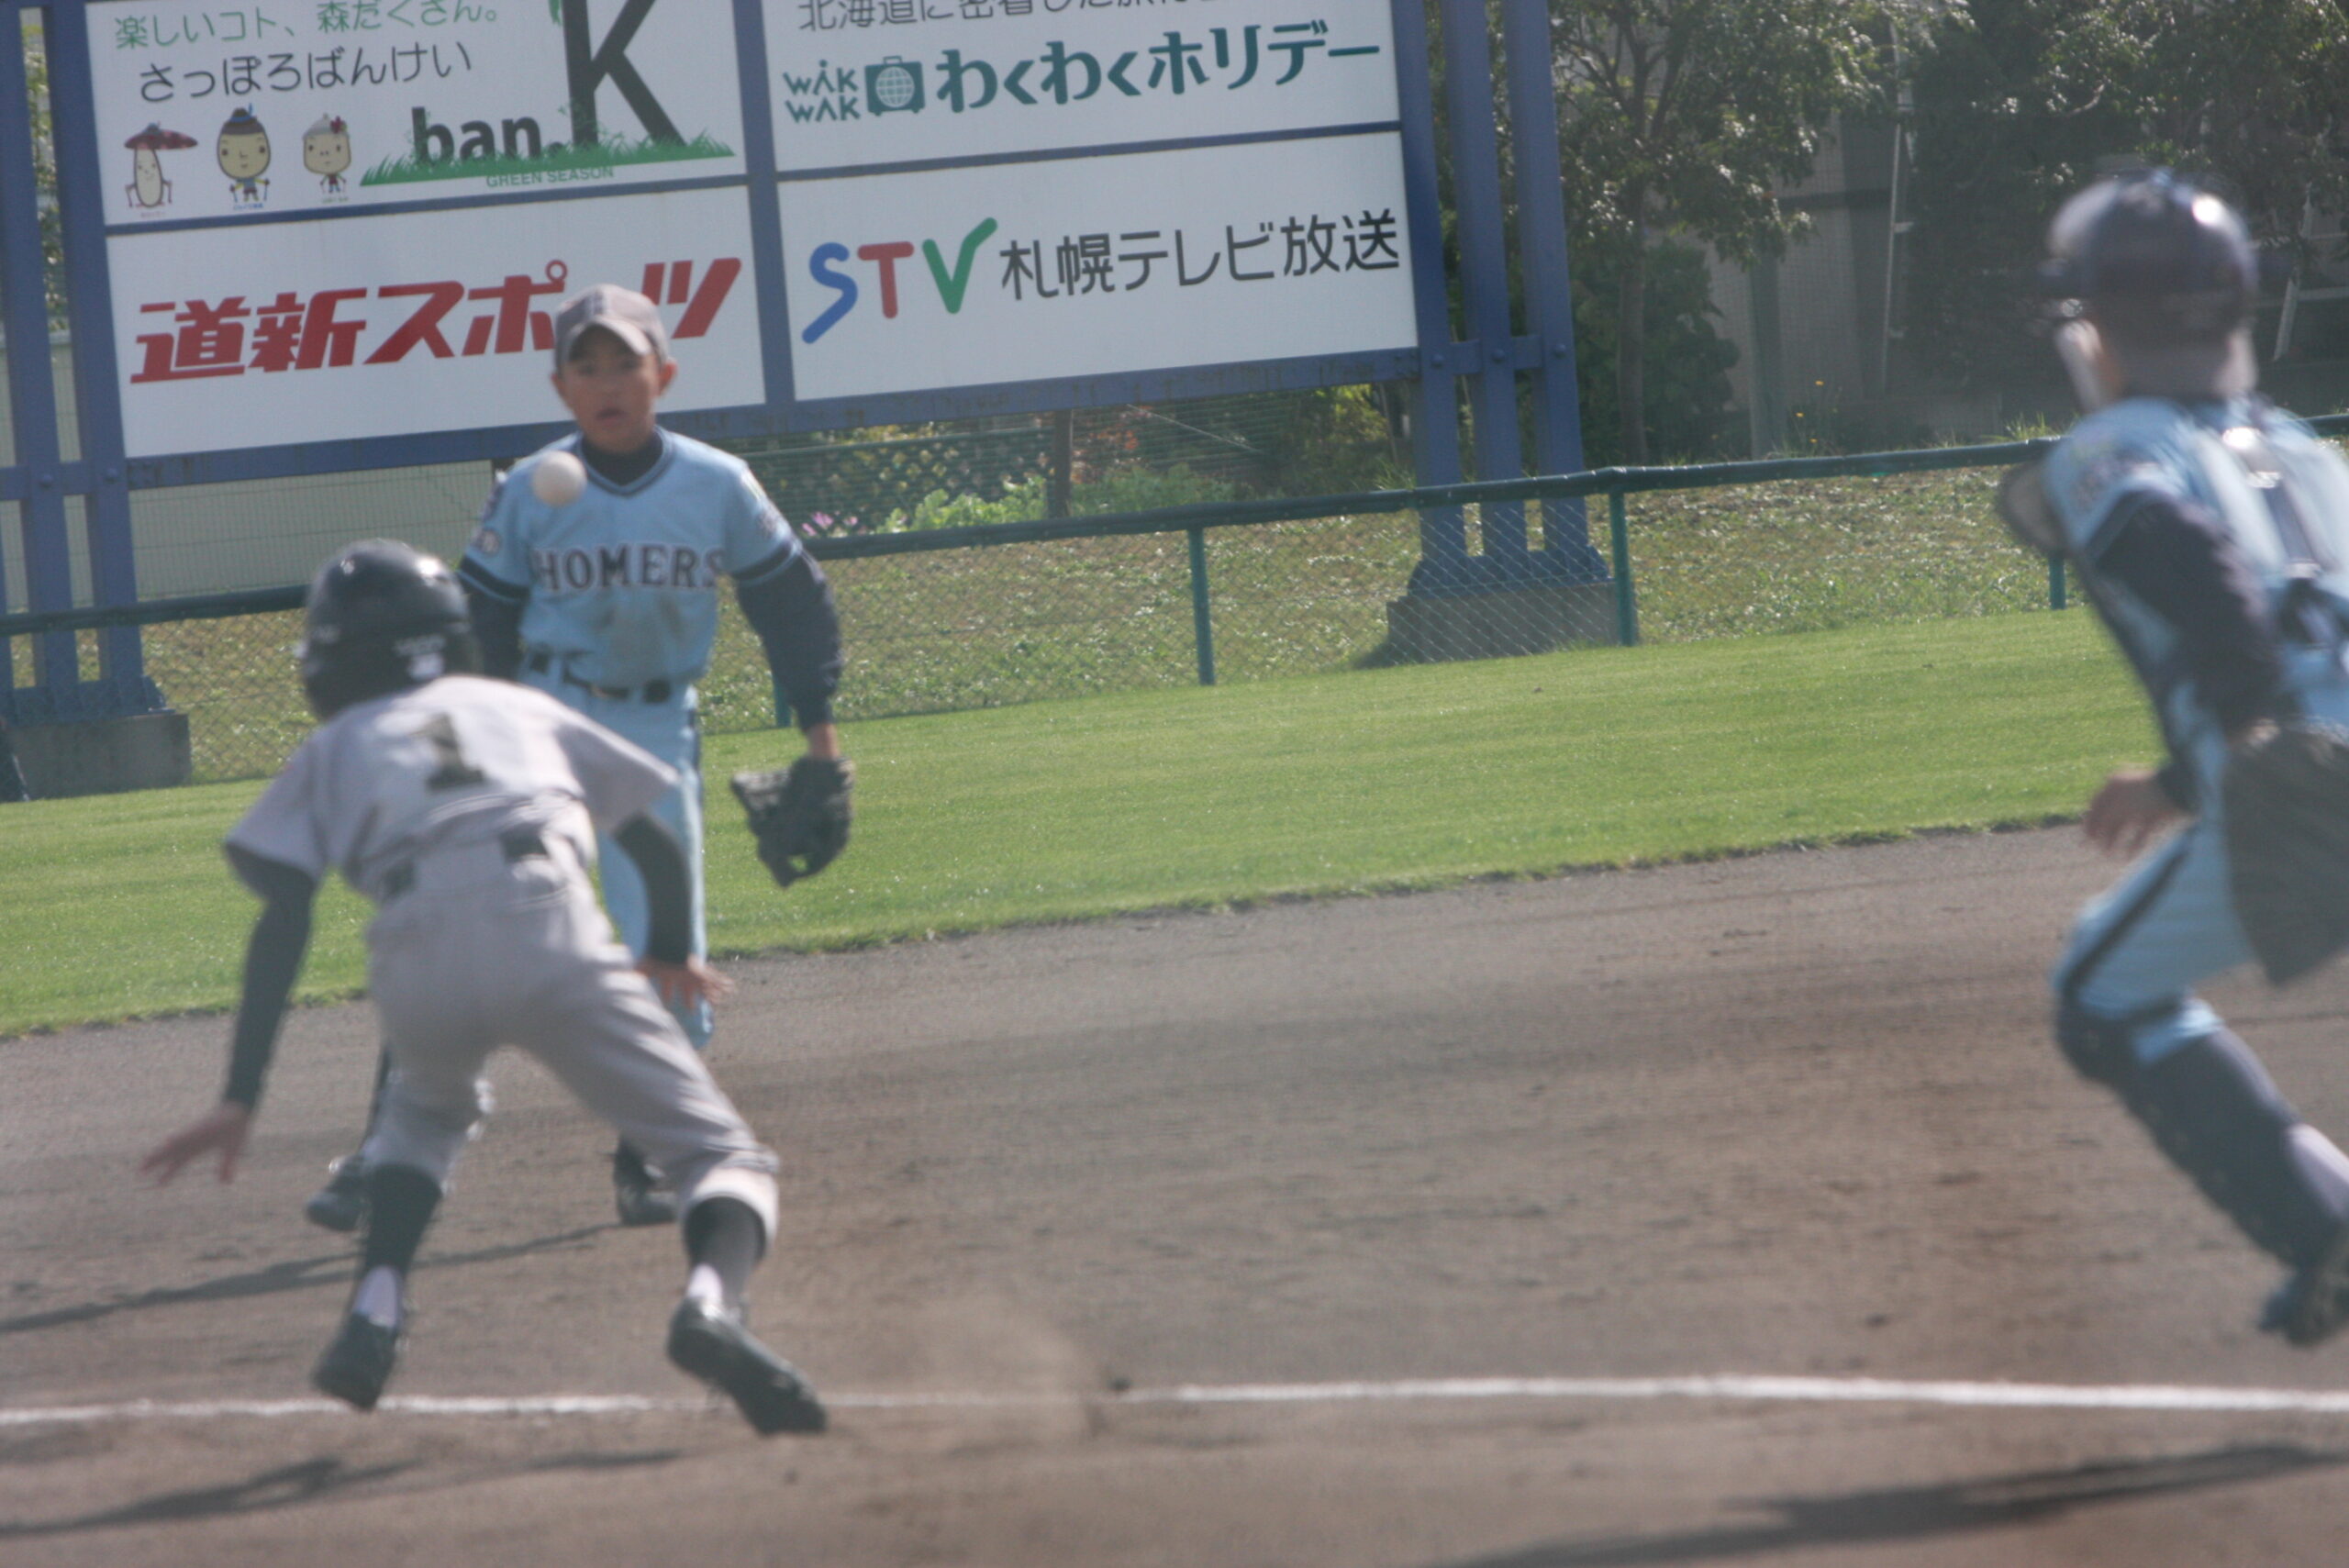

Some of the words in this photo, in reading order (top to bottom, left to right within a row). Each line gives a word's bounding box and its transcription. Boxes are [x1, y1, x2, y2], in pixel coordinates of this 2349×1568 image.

[139, 41, 472, 103] さっぽろばんけい
[936, 19, 1381, 114] わくわくホリデー
[485, 172, 543, 188] GREEN
[547, 166, 614, 183] SEASON
[129, 257, 742, 384] 道新スポツ
[800, 217, 998, 344] STV
[998, 207, 1400, 301] 札幌テレビ放送
